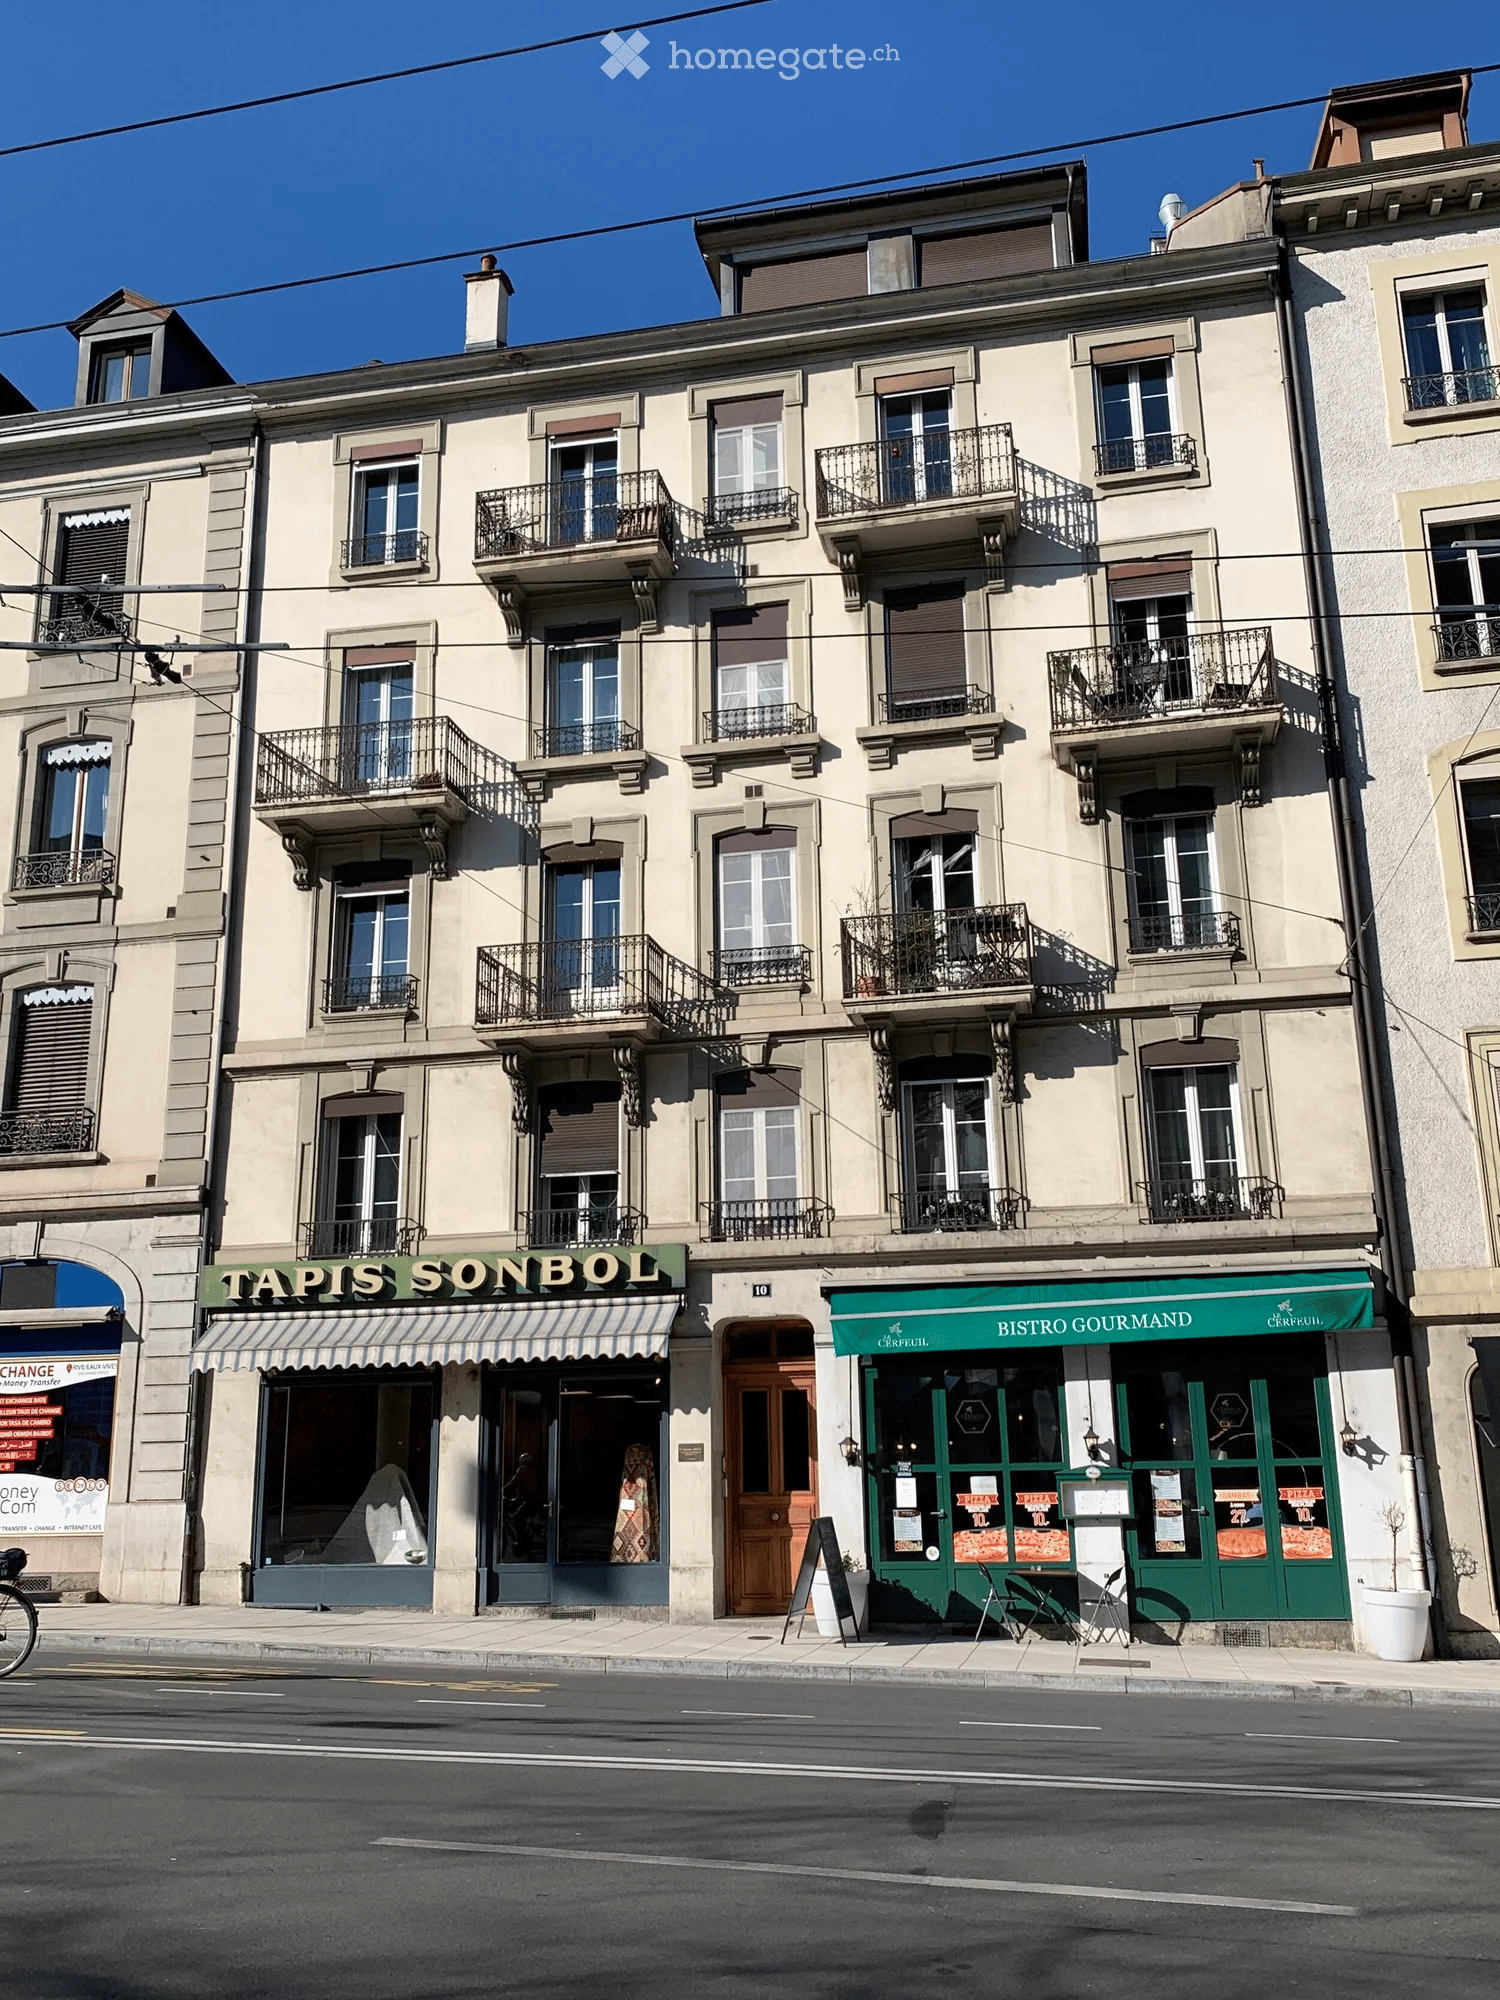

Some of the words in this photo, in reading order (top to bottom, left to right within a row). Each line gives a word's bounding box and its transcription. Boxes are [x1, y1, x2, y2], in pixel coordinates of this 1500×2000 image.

[221, 1263, 386, 1300] TAPIS
[411, 1251, 660, 1292] SONBOL
[755, 1285, 768, 1296] 10
[997, 1318, 1058, 1337] BISTRO
[1071, 1311, 1192, 1333] GOURMAND
[0, 1365, 54, 1378] CHANGE
[30, 1378, 61, 1386] Transfer
[1024, 1494, 1050, 1503] PIZZA
[1287, 1489, 1315, 1499] PIZZA
[964, 1495, 991, 1505] PIZZA
[0, 1499, 36, 1514] Com
